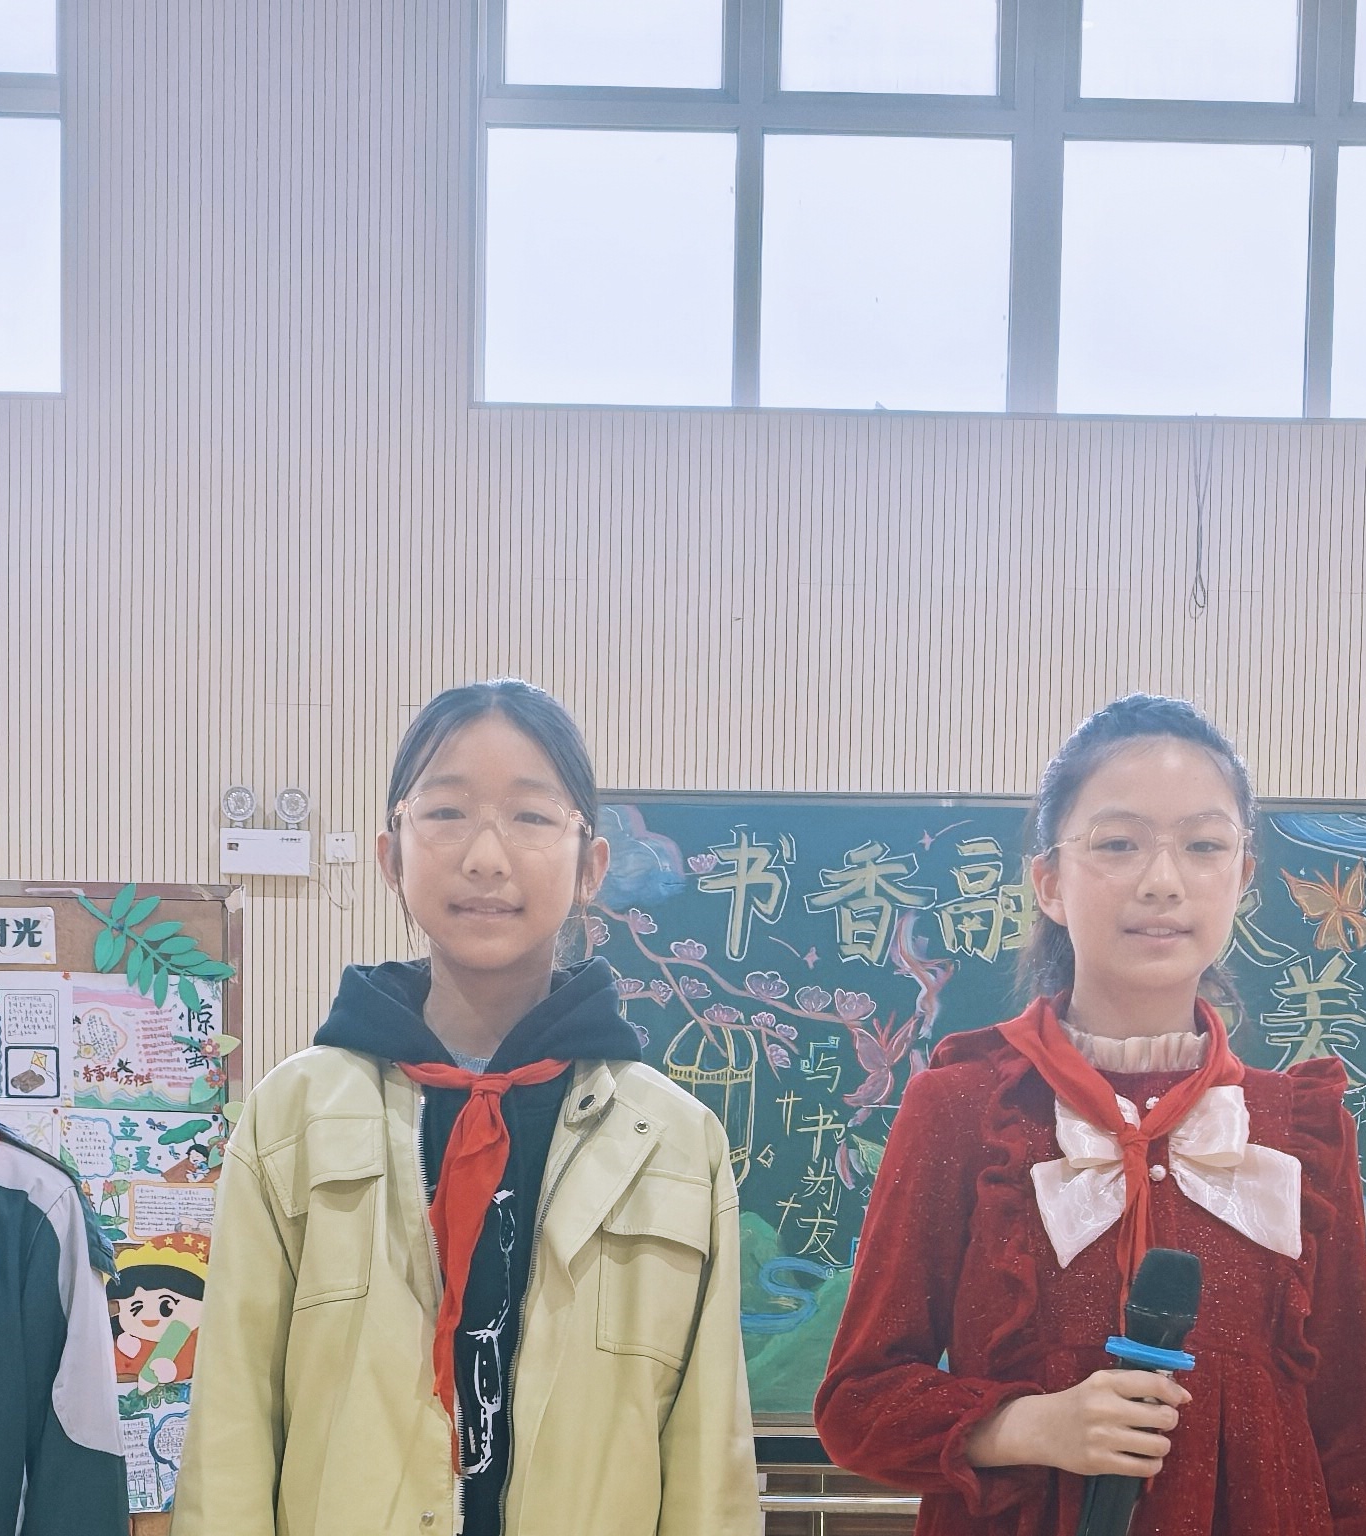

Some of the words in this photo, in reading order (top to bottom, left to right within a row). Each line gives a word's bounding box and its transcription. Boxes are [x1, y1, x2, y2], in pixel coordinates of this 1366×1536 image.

[115, 1116, 163, 1174] 立夏
[797, 1052, 843, 1265] 与书为友
